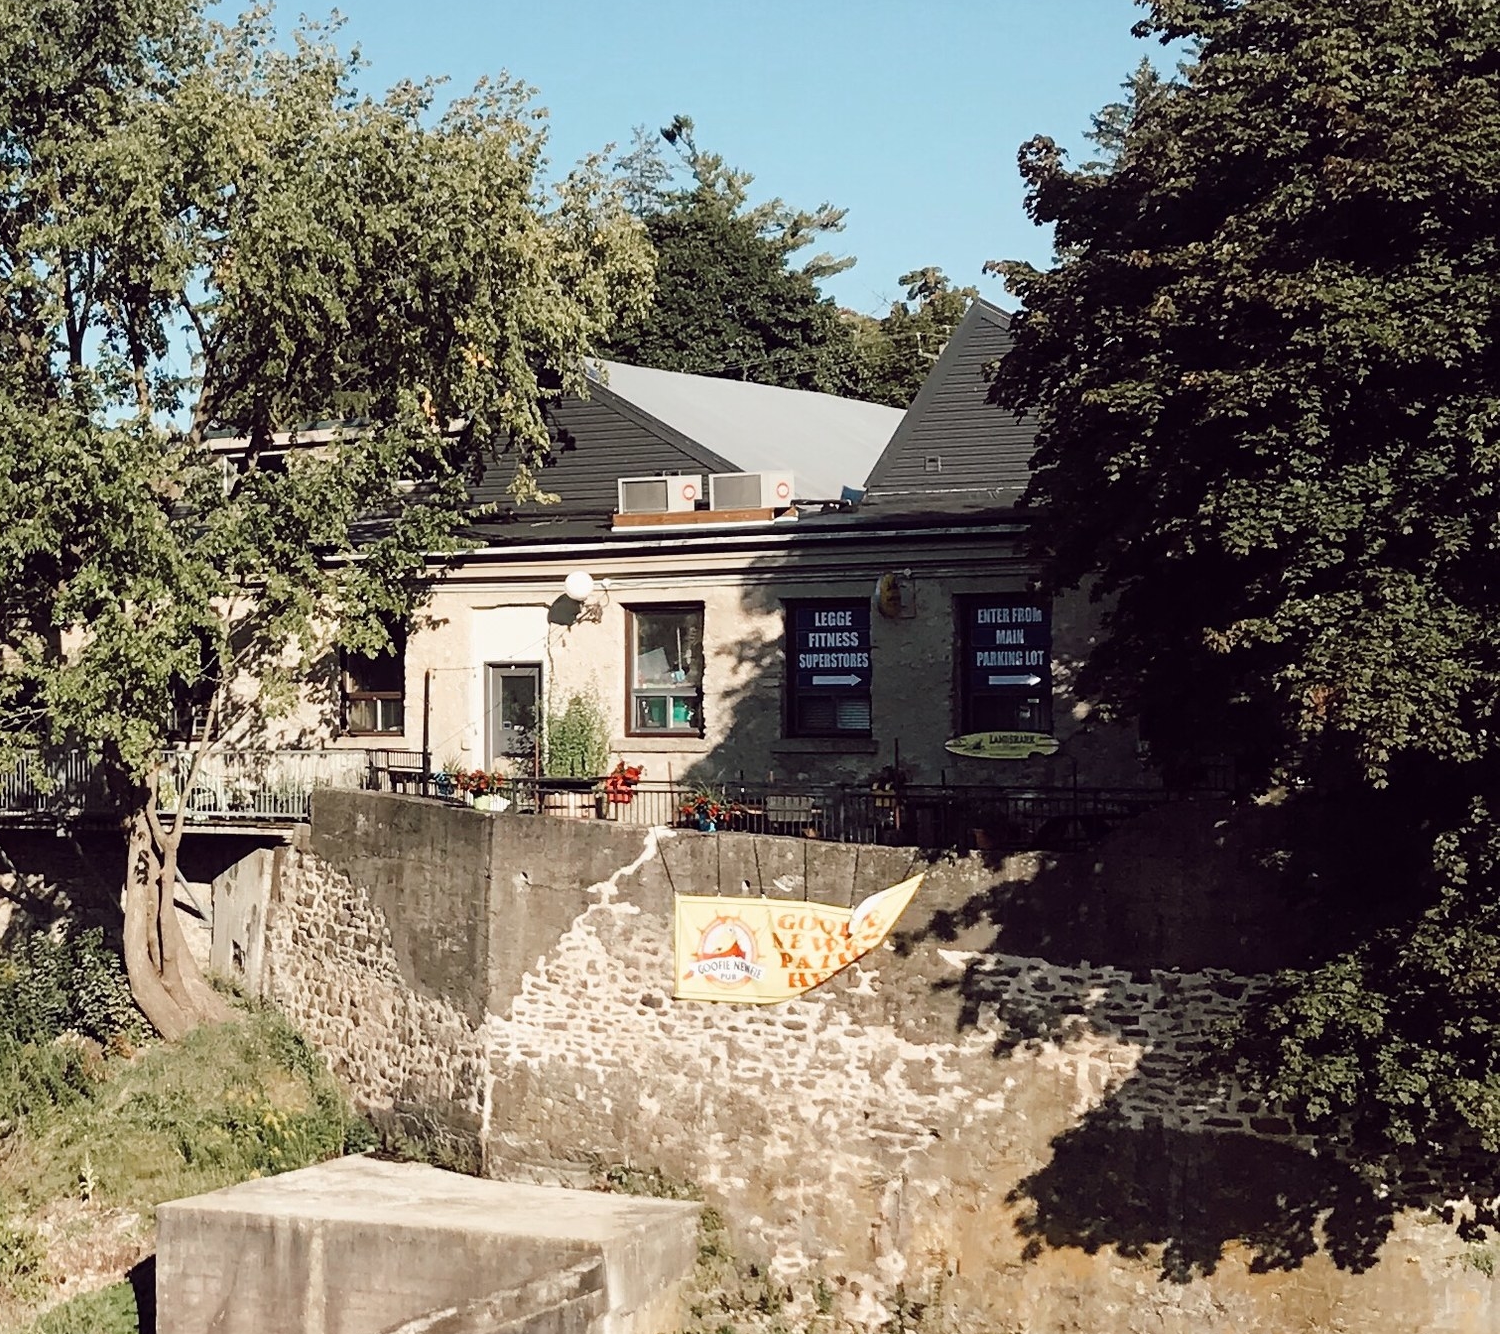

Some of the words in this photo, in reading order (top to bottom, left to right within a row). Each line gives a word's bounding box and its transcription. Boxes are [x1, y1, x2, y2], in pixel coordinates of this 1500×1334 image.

[815, 611, 852, 626] LEGGE
[977, 608, 1010, 623] ENTER
[1012, 607, 1042, 622] FROM
[808, 632, 859, 647] FITNESS
[996, 629, 1025, 645] MAIN
[799, 652, 869, 668] SUPERSTORES
[976, 651, 1023, 666] PARKING
[1025, 650, 1044, 665] LOT
[698, 960, 730, 974] GOOFIE
[733, 960, 762, 979] NEWFIE
